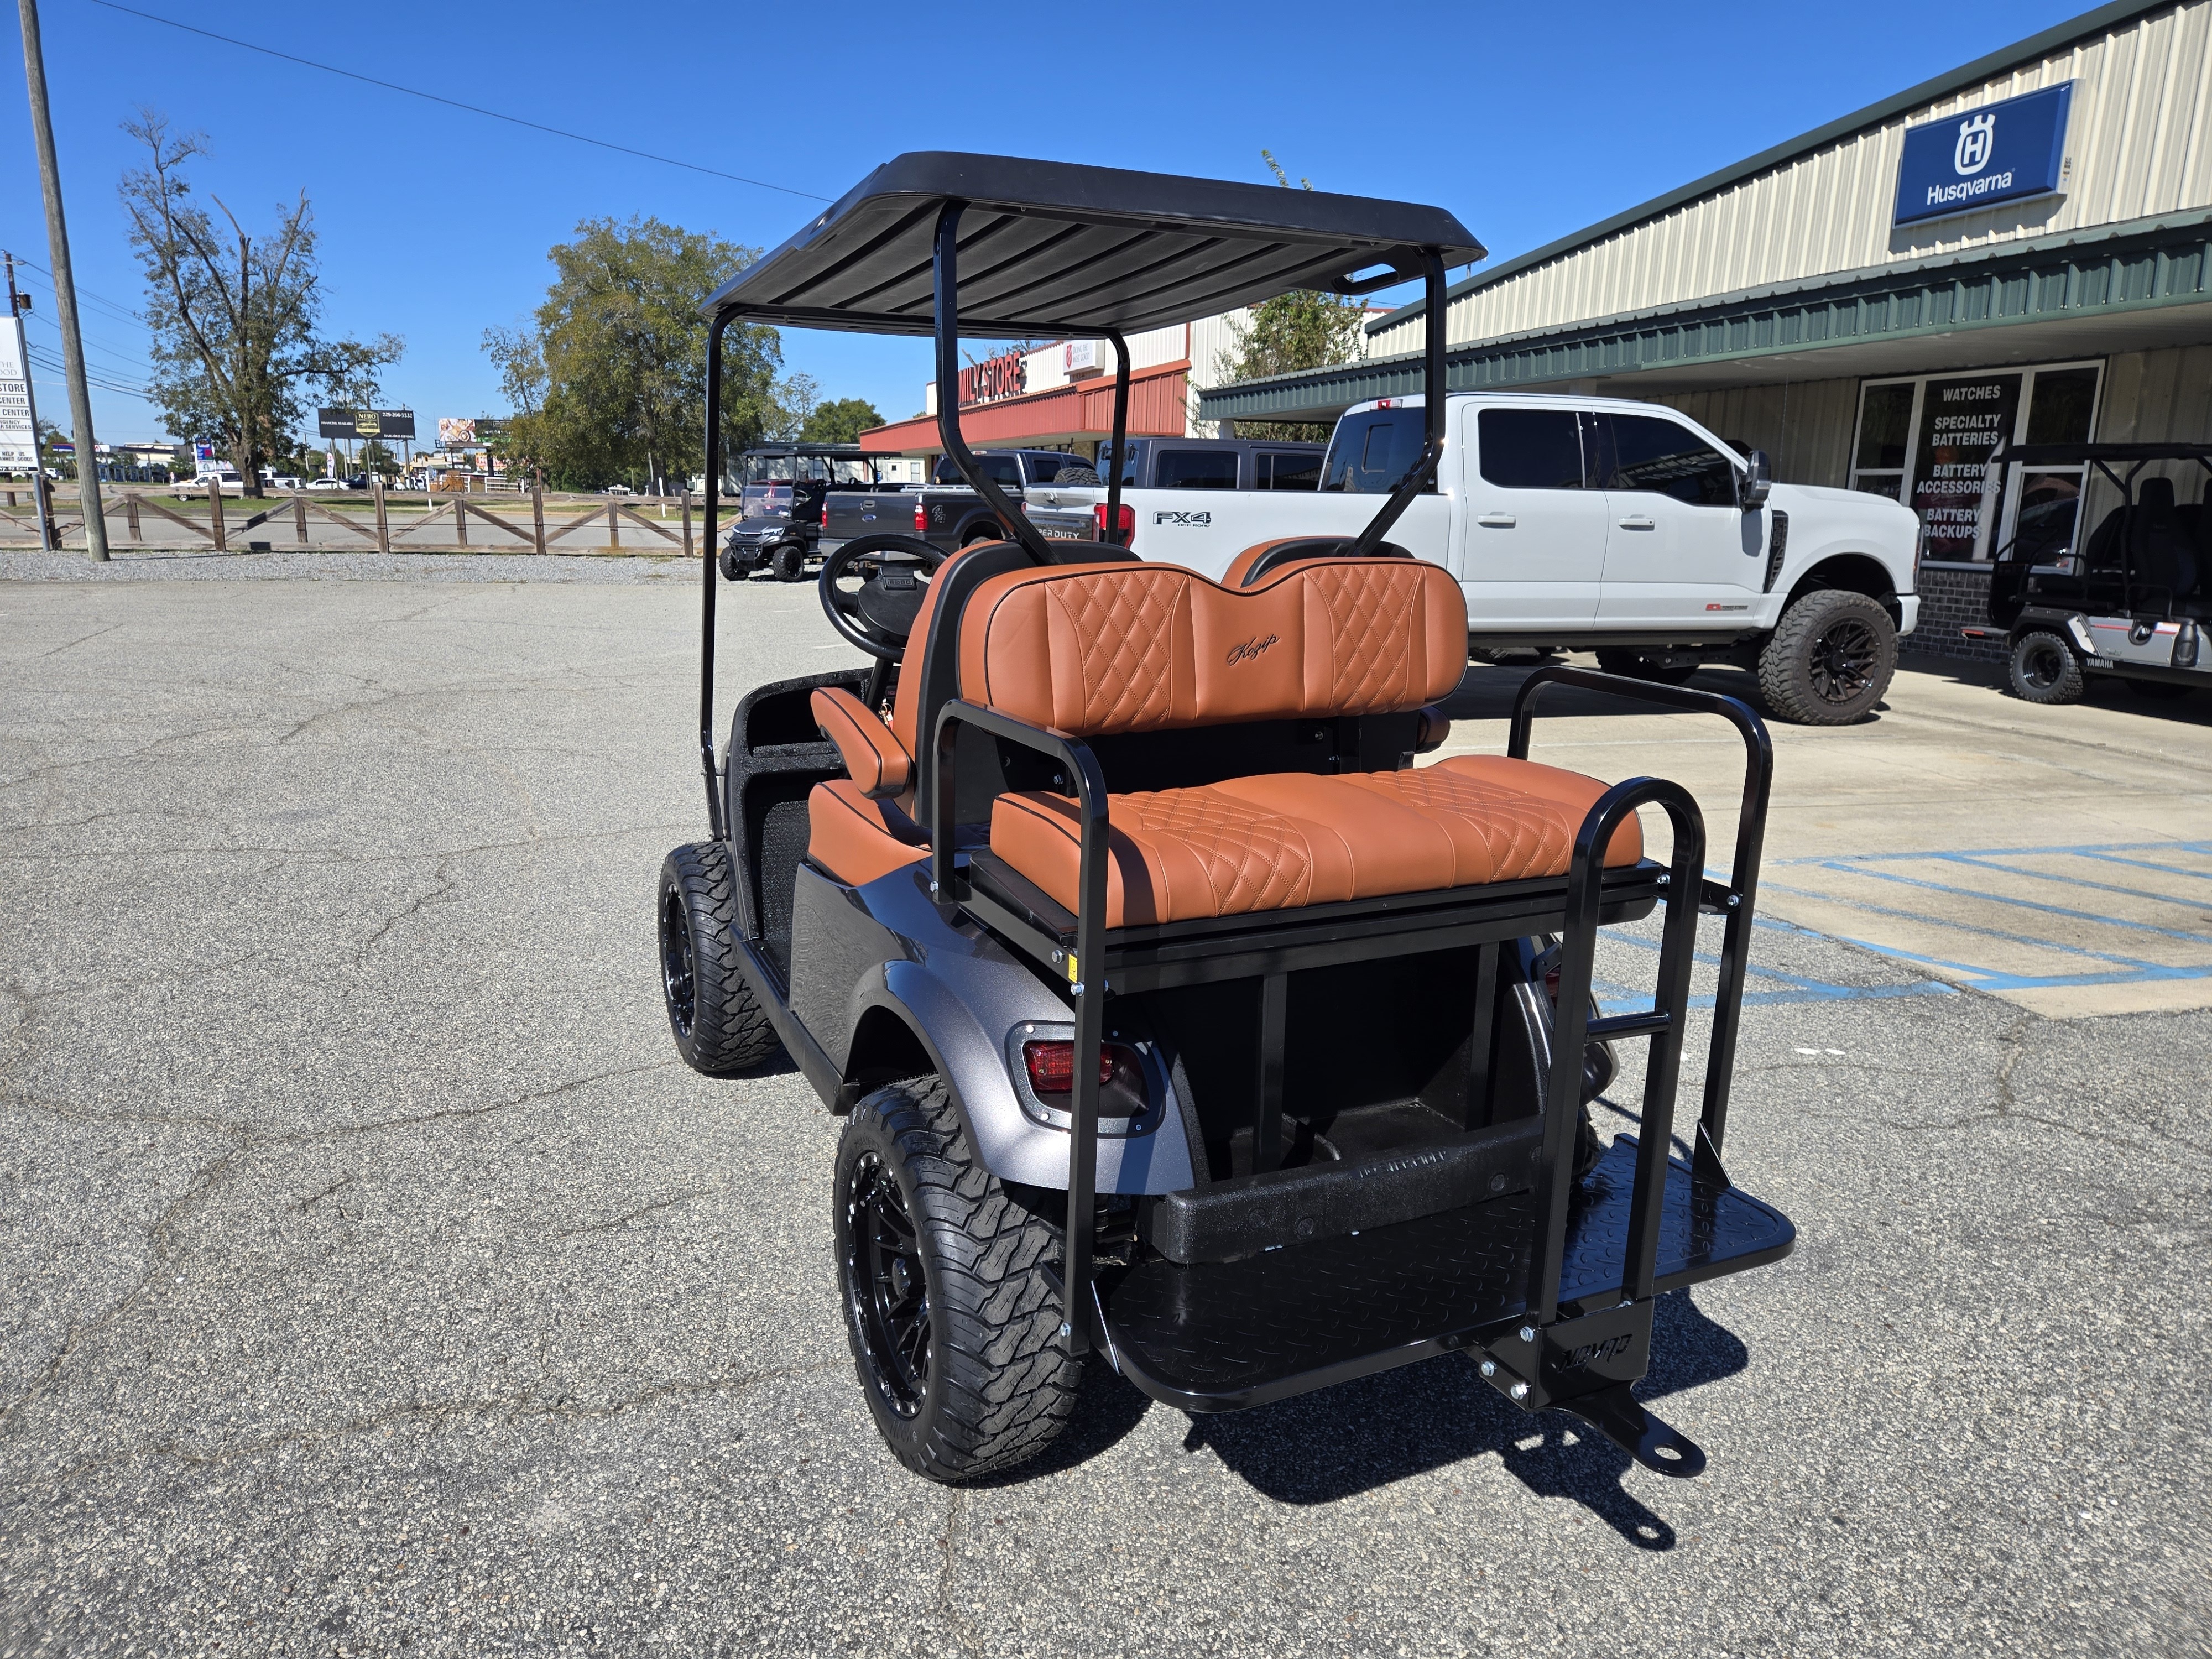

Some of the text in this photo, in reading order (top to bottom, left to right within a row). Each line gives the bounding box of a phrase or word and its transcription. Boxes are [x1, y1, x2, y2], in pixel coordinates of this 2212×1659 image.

[1927, 171, 2013, 206] Husqvarna
[959, 351, 1021, 403] MILY STORE
[1943, 385, 2001, 402] WATCHES
[1934, 414, 2001, 430] SPECIALTY
[1932, 431, 1999, 446] BATTERIES
[1933, 463, 1988, 478] BATTERY
[1917, 480, 2001, 494] ACCESSORIES
[1153, 511, 1212, 525] FX4
[1926, 508, 1981, 523] BATTERY
[1037, 528, 1079, 540] PER DUTY
[1924, 524, 1981, 539] BACKUPS
[2086, 658, 2114, 669] YAMAHA
